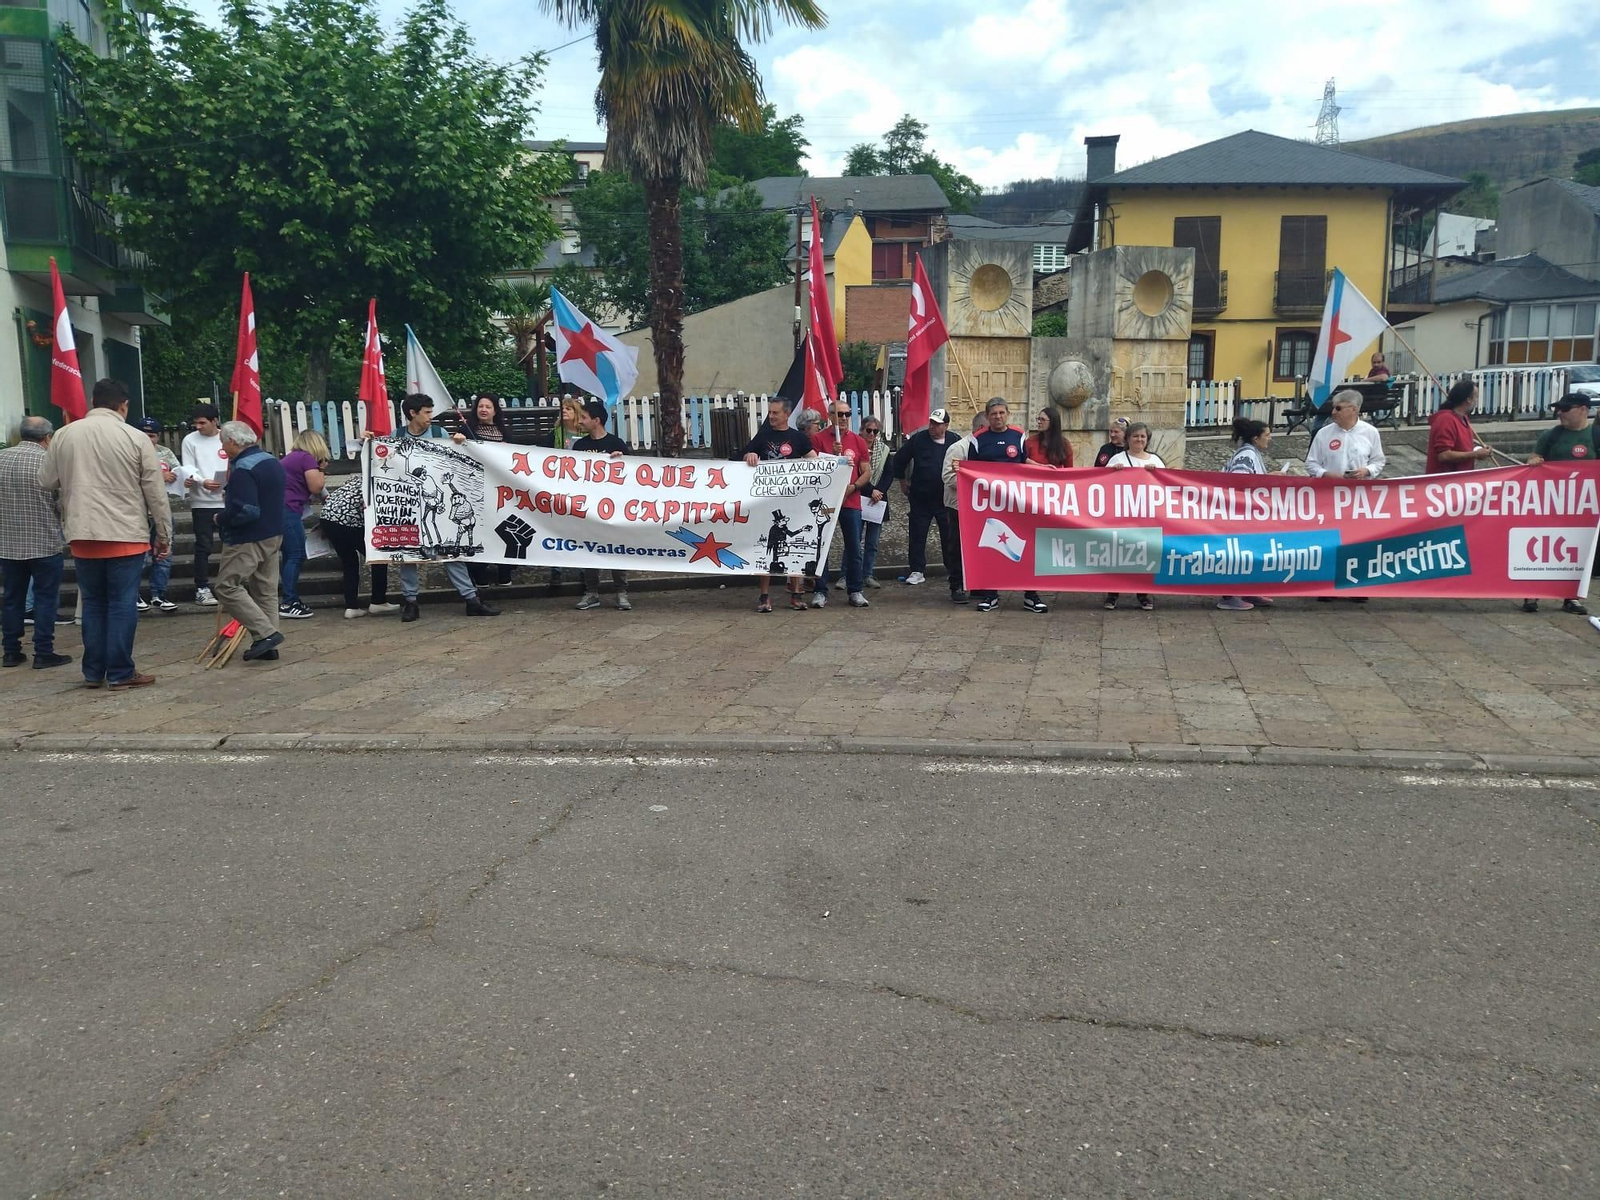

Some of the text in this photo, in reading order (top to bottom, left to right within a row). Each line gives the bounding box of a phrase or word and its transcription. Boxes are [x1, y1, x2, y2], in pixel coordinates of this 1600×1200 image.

[509, 452, 730, 489] A CRISE QUE A
[495, 485, 750, 526] PAGUE O CAPITAL
[971, 471, 1600, 525] CONTRA O IMPERIALISMO, PAZ E SOBERANÍA
[541, 537, 687, 558] CIG-Valdeorras
[1051, 531, 1156, 572] Na Galiza,
[1166, 537, 1323, 584] traballo digno
[1346, 539, 1467, 584] e dereitos
[1526, 535, 1579, 564] CIG
